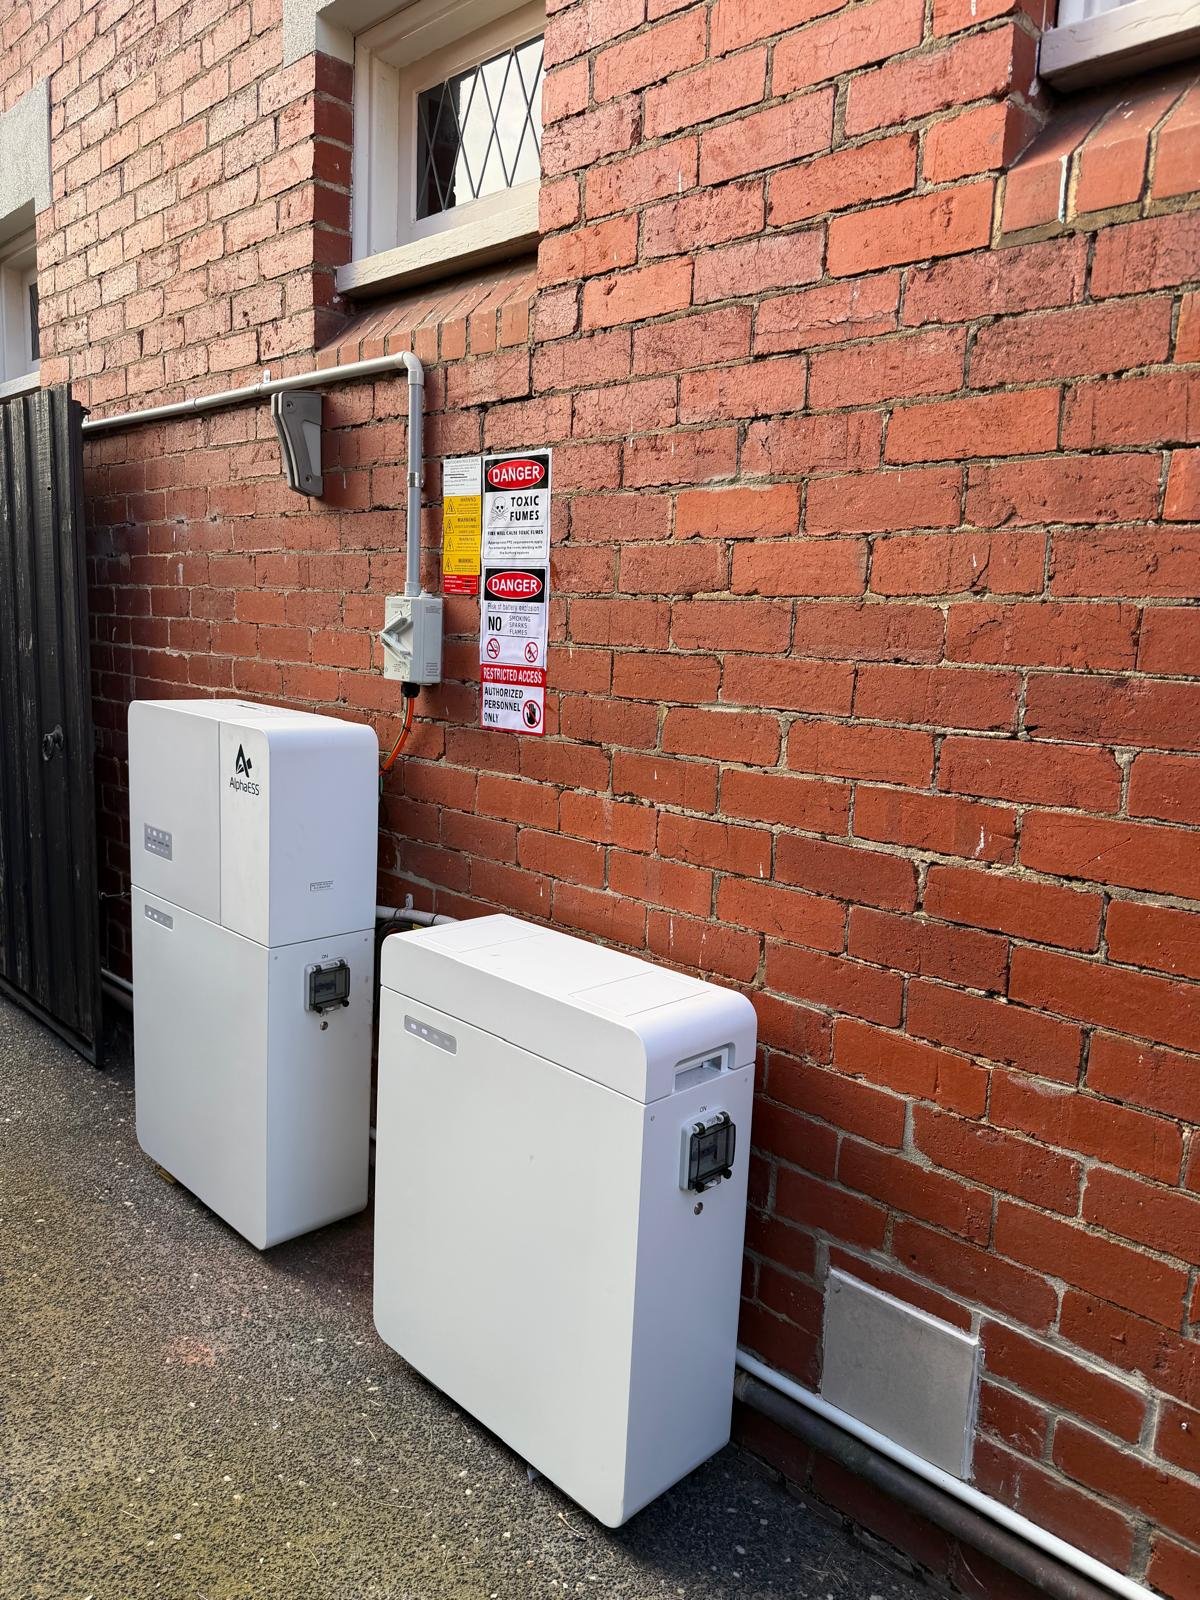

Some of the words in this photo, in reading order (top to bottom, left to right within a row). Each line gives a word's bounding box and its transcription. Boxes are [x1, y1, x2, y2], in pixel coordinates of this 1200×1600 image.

[492, 465, 540, 482] DANGER
[510, 495, 539, 507] TOXIC
[510, 510, 539, 521] FUMES
[492, 578, 537, 592] DANGER
[488, 616, 501, 631] NO
[484, 668, 517, 682] RESTRICTED
[518, 670, 542, 683] ACCESS
[484, 687, 523, 699] AUTHORIZED
[484, 699, 520, 712] PERSONNEL
[484, 712, 499, 723] ONLY
[230, 777, 259, 796] AlphaESS
